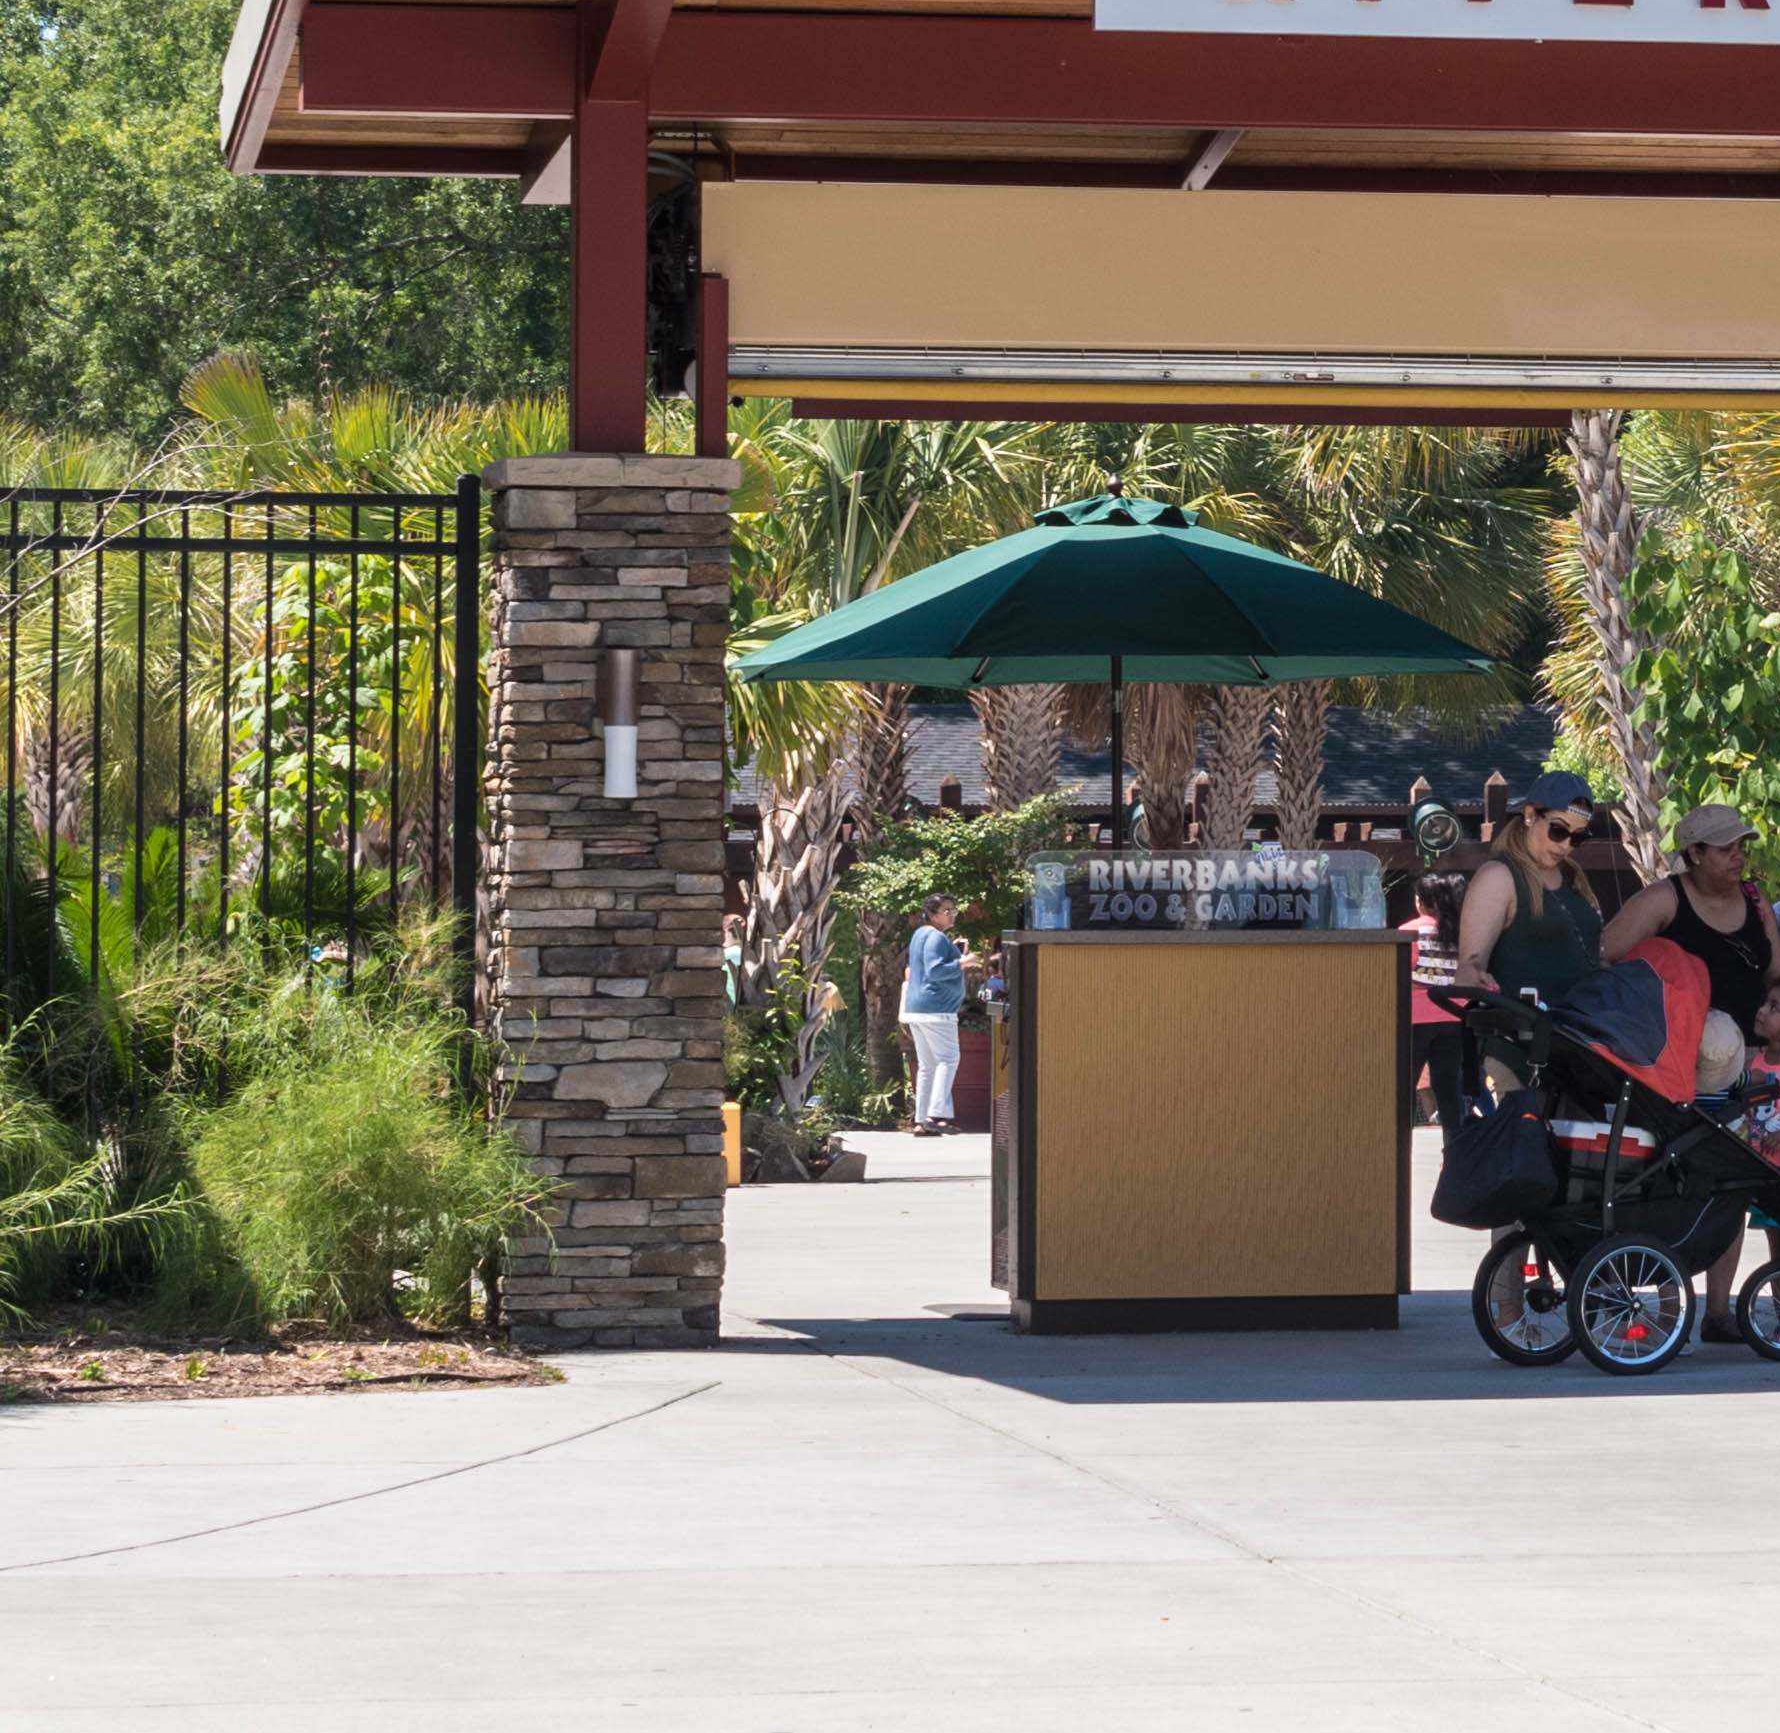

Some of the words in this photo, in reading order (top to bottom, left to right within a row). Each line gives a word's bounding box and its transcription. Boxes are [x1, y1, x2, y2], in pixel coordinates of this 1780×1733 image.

[1089, 860, 1318, 891] RIVERBANKS
[1089, 893, 1157, 921] ZOO
[1166, 894, 1186, 920] &
[1195, 894, 1319, 921] GARDEN
